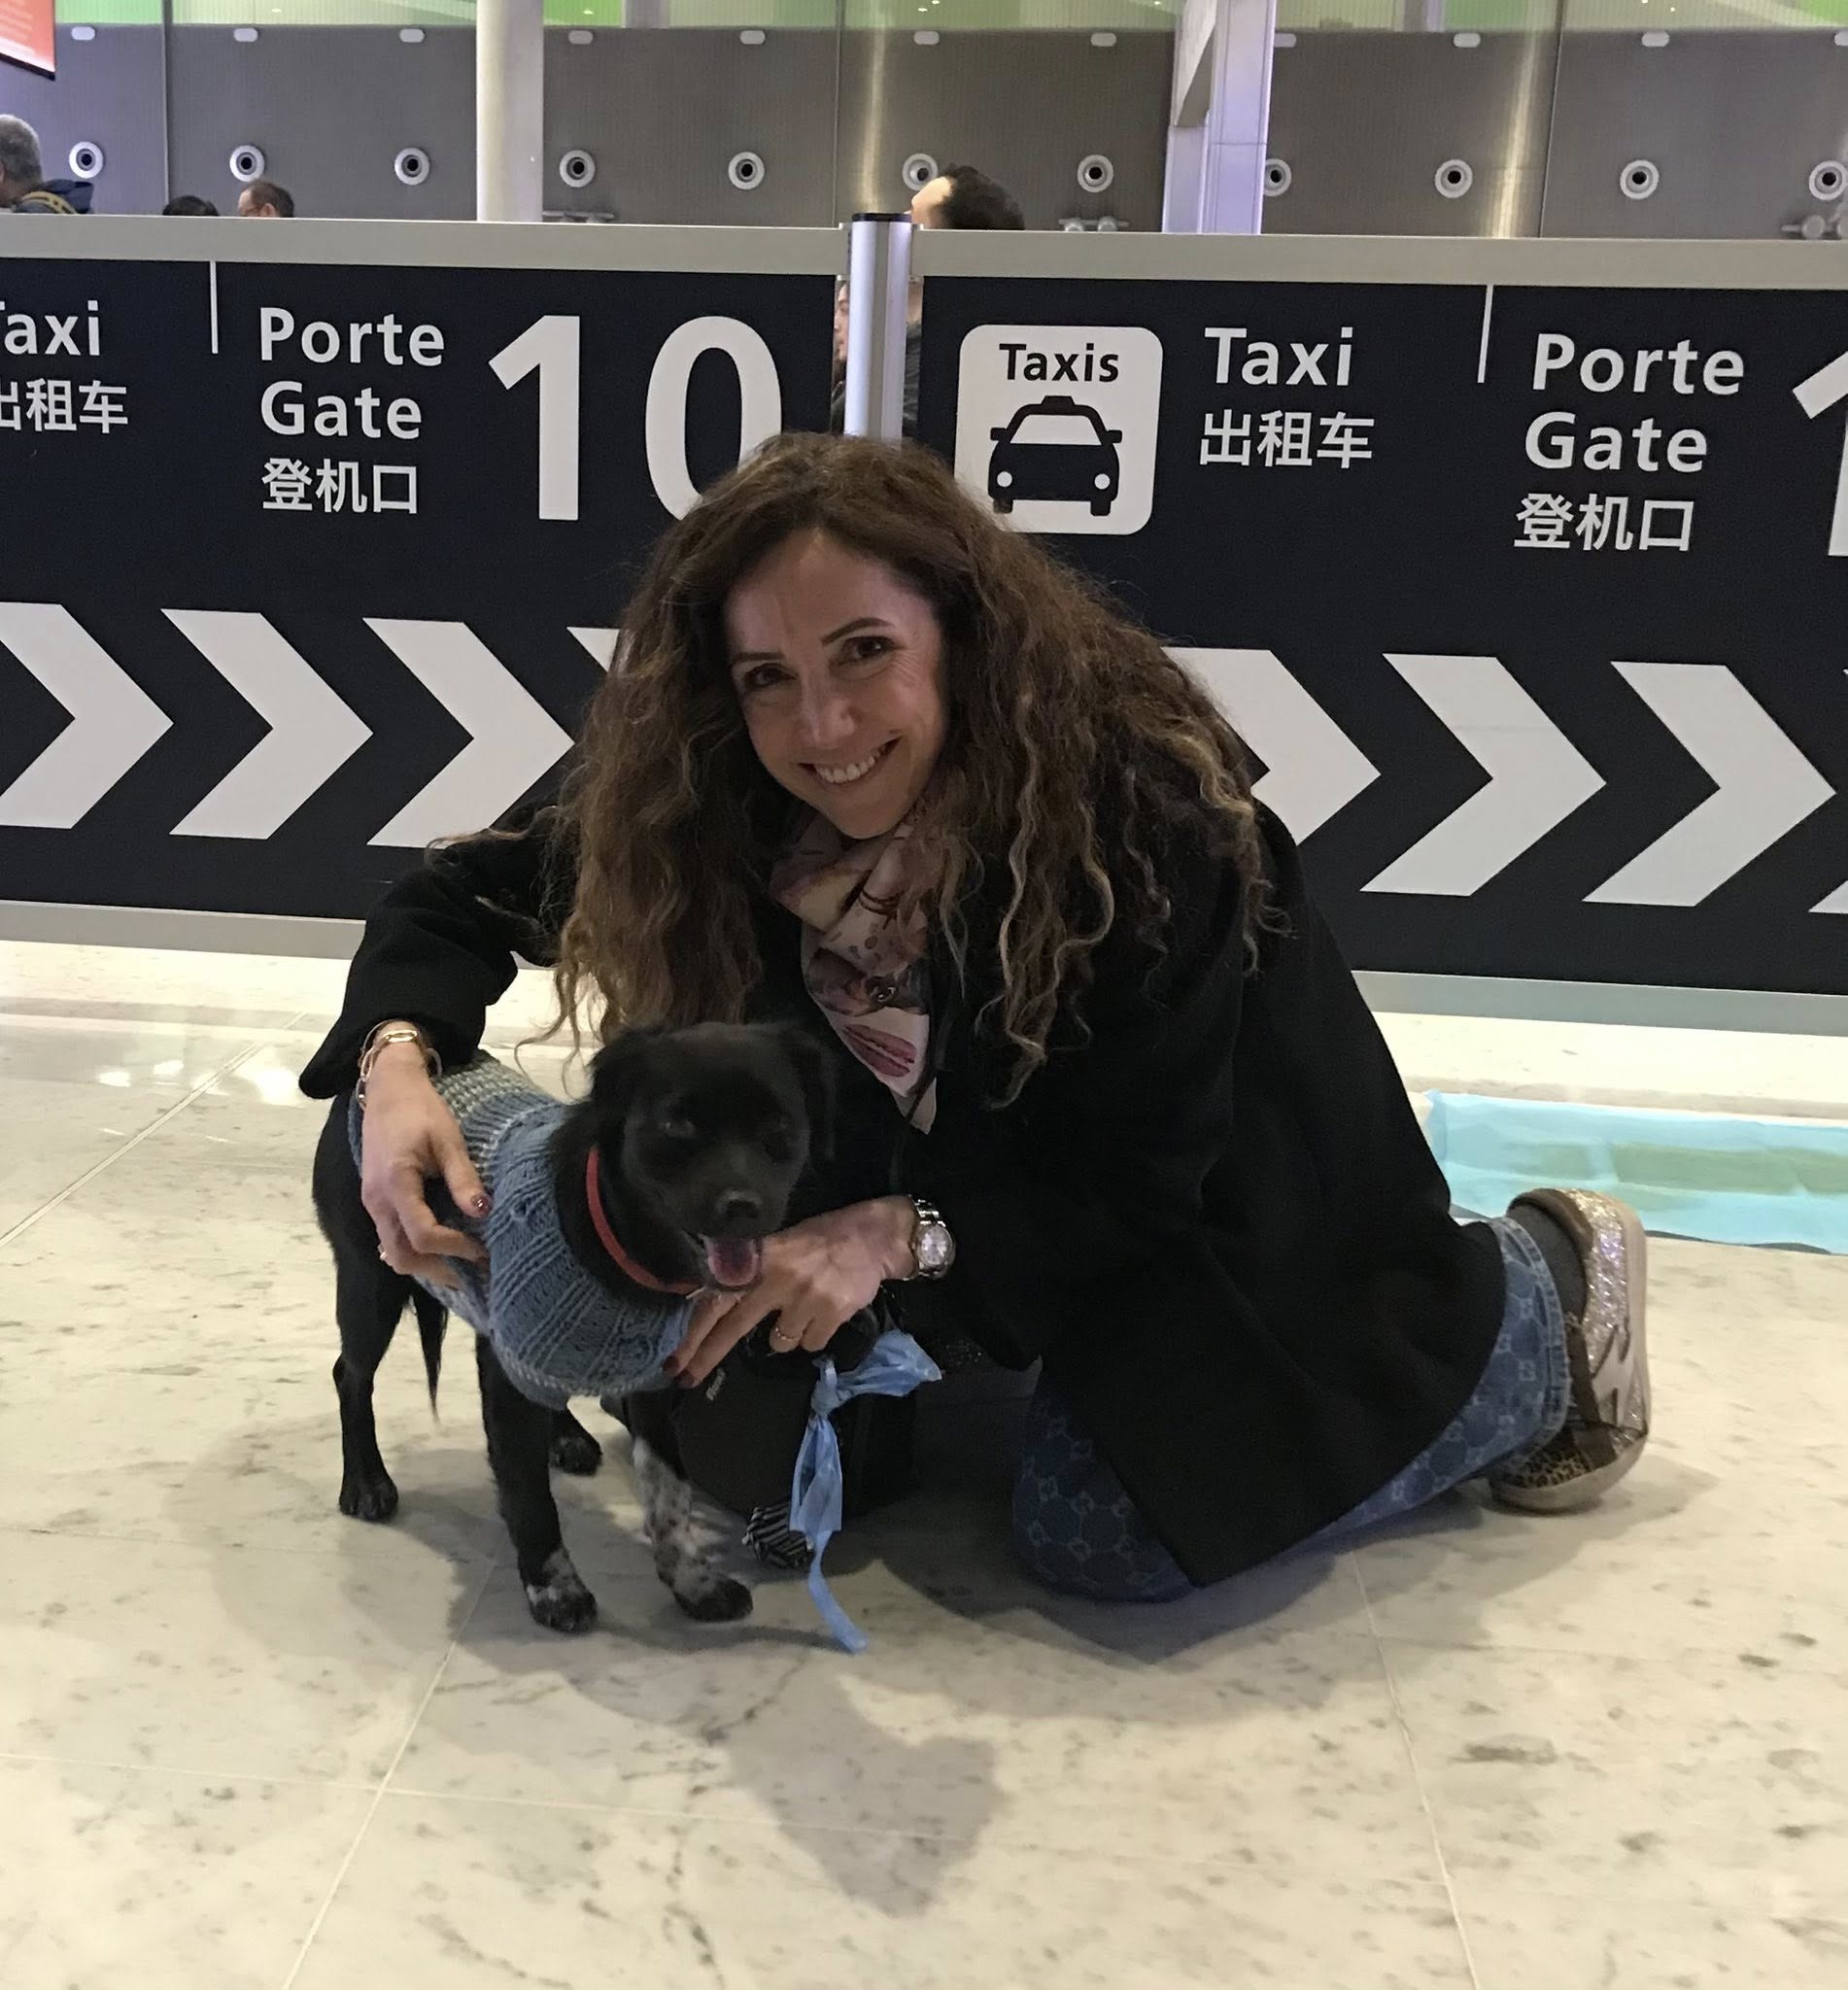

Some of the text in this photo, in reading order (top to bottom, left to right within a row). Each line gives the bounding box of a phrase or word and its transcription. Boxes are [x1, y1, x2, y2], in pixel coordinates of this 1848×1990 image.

[0, 300, 99, 356] axi
[260, 307, 445, 366] Porte
[1204, 326, 1353, 387] Taxi
[999, 342, 1119, 383] Taxis
[1532, 333, 1744, 395] Porte
[260, 381, 422, 440] Gate
[488, 315, 781, 522] 10
[1199, 409, 1375, 469] 出租车
[1524, 412, 1707, 473] Gate
[261, 459, 418, 514] 登机口
[1514, 493, 1694, 552] 登机口
